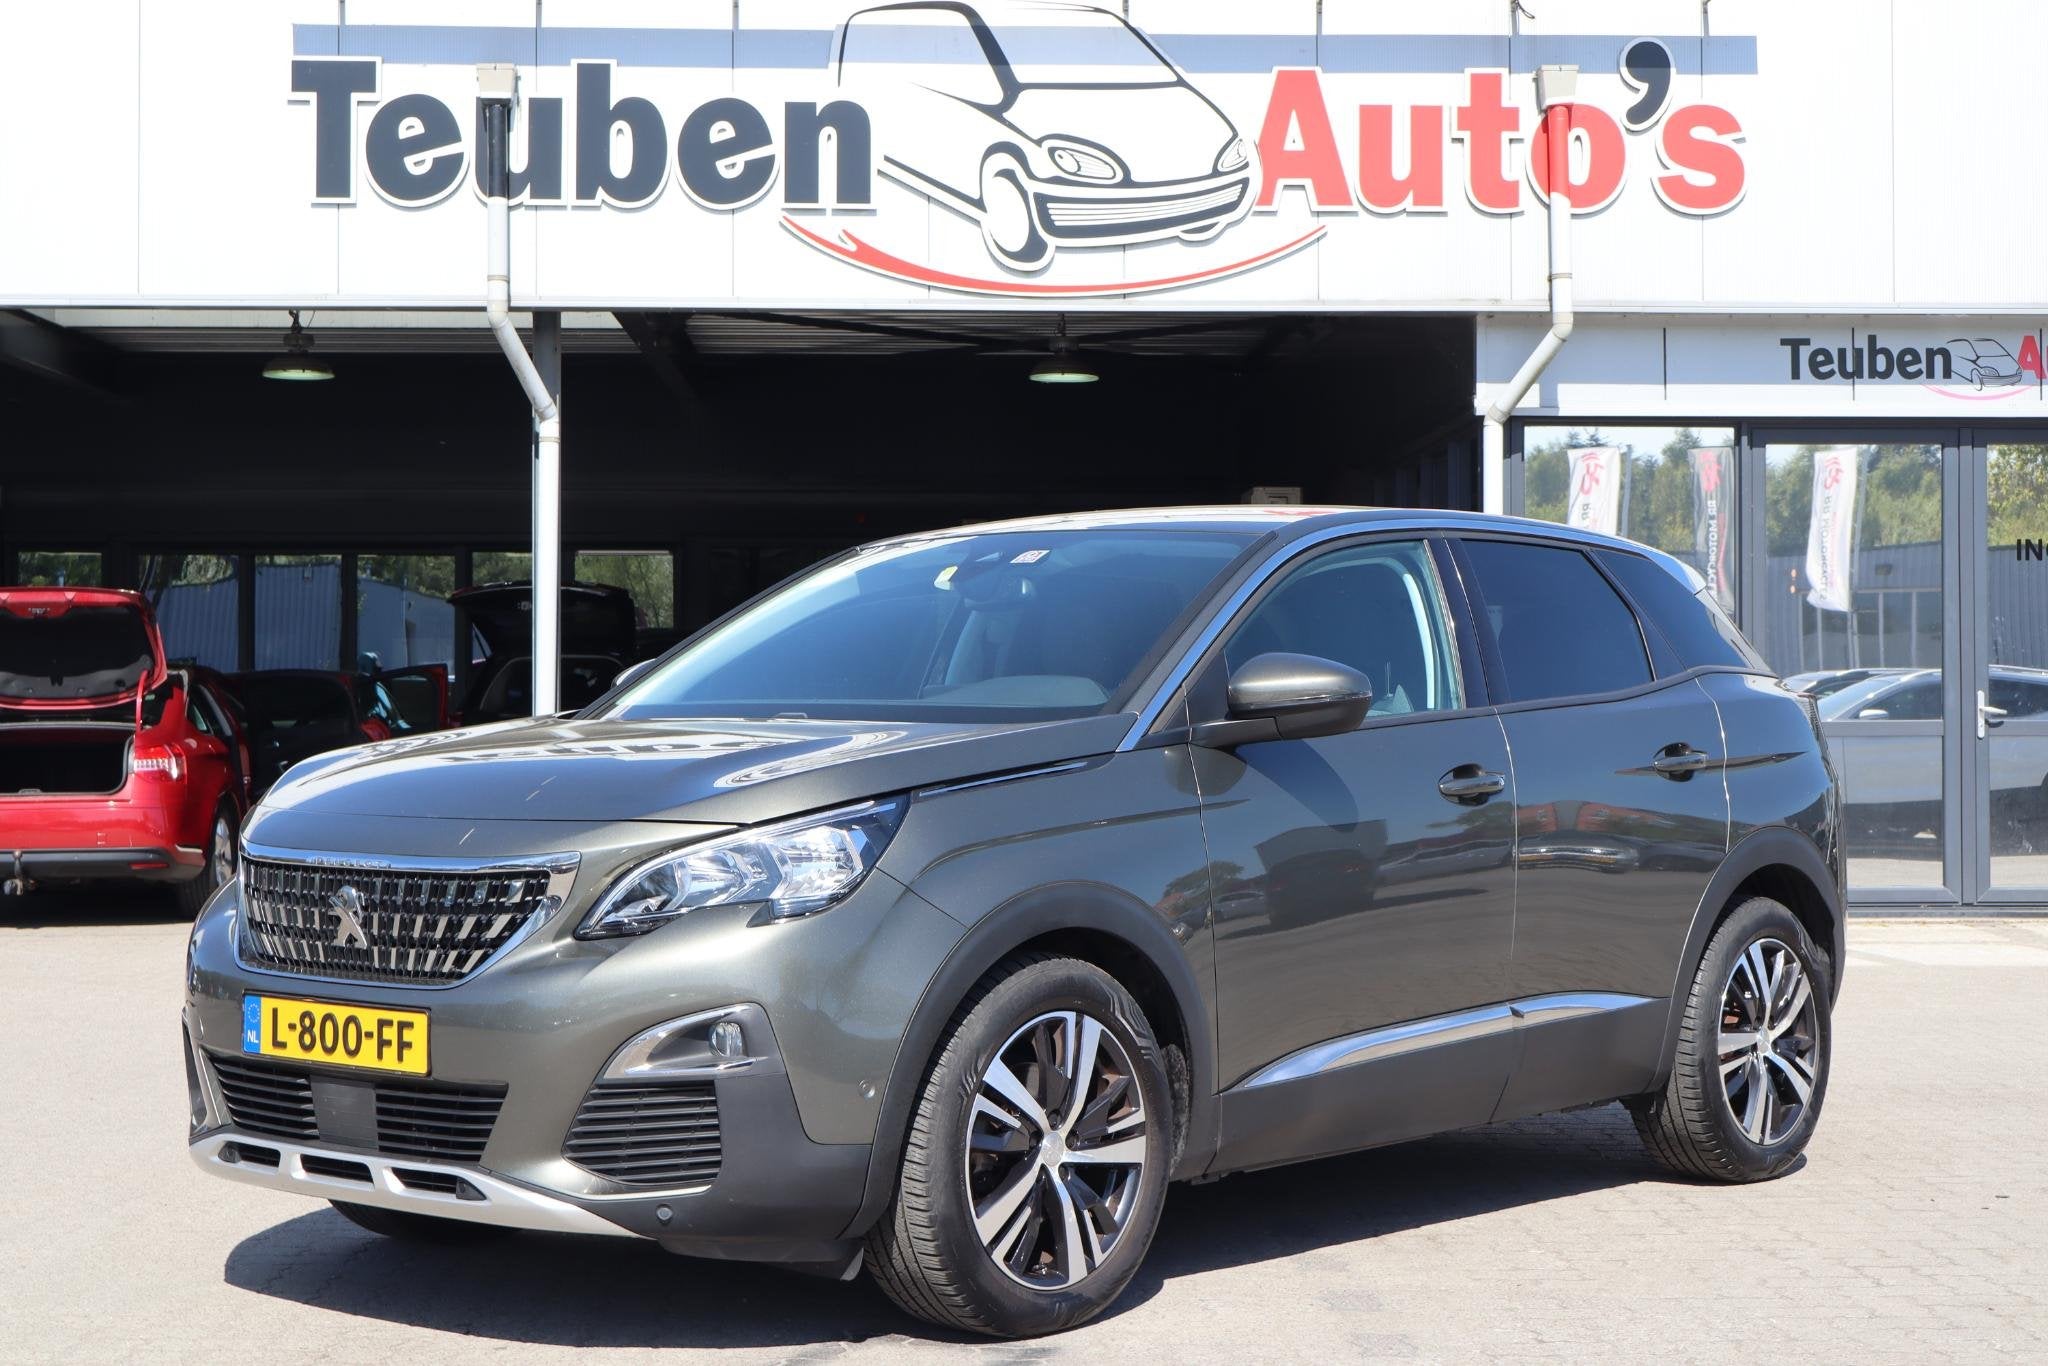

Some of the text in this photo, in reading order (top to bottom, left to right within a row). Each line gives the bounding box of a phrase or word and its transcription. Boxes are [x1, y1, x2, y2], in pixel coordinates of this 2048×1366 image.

[291, 40, 1747, 210] Teuben Auto's
[1780, 334, 2048, 381] Teuben A
[2016, 538, 2048, 561] IN
[247, 1029, 260, 1043] NL
[271, 1007, 415, 1063] L-800-FF
